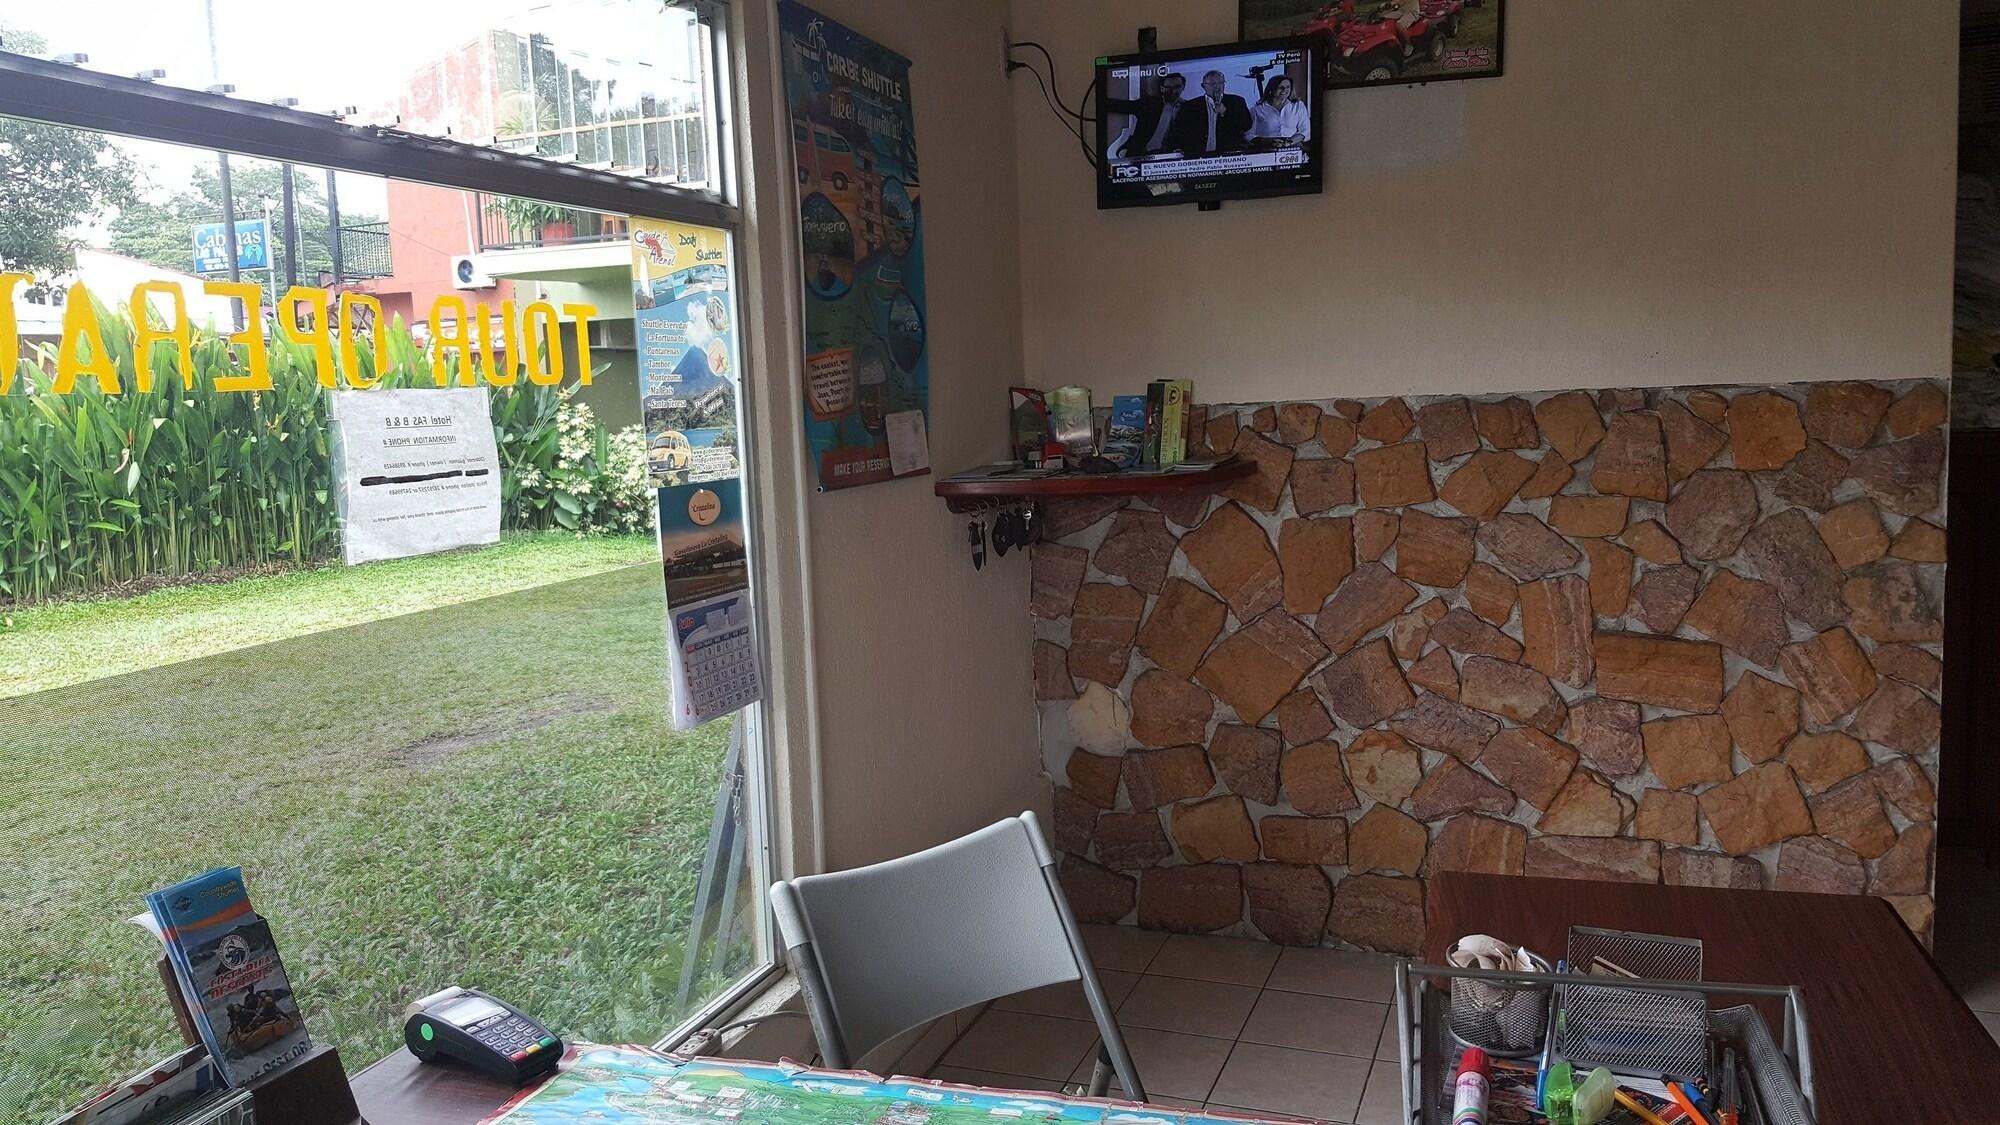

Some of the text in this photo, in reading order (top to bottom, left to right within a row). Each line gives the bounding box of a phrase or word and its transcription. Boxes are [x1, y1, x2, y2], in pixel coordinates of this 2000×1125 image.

[826, 50, 860, 82] CARIBE
[862, 67, 902, 102] SHUTTLE
[1279, 155, 1298, 163] CNN
[1178, 160, 1212, 168] GOBIERNO
[642, 319, 663, 328] Shuttle
[656, 334, 679, 342] Fortuna
[649, 374, 682, 382] Montezuma
[834, 463, 851, 476] MAKE
[852, 461, 866, 474] YOUR
